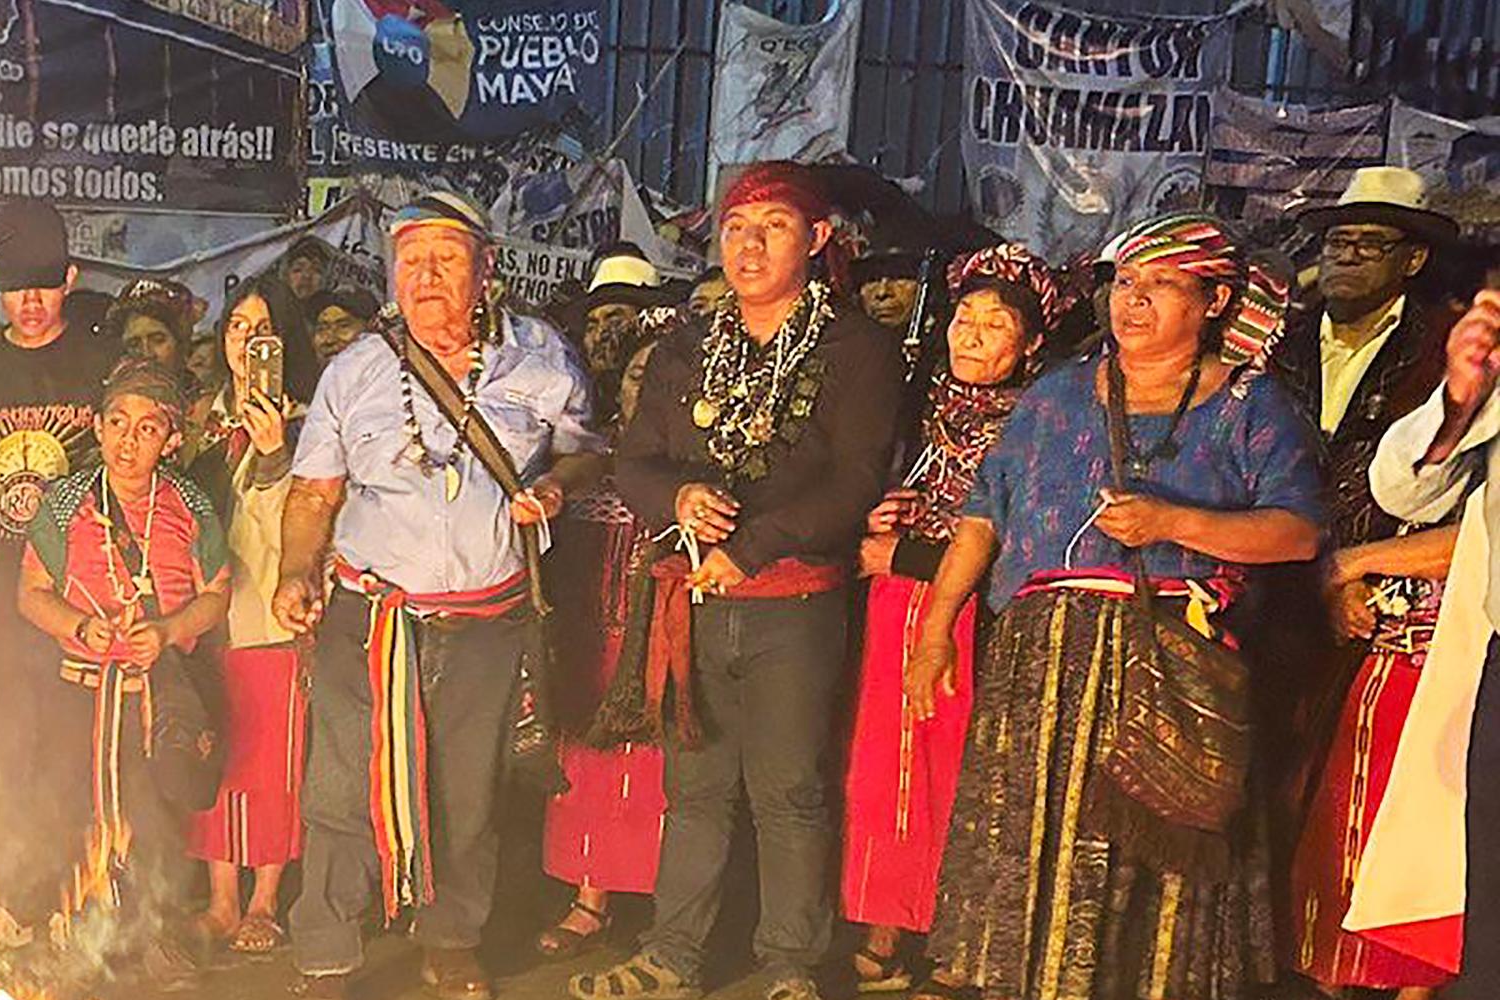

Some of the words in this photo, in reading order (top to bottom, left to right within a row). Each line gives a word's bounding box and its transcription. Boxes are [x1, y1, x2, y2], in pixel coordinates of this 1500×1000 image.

[478, 33, 599, 69] PUEBLO
[476, 64, 576, 104] MAYA
[42, 121, 78, 150] se
[82, 120, 176, 155] quede
[182, 122, 274, 161] atrás!!
[74, 165, 164, 202] todos.
[528, 253, 551, 277] NO
